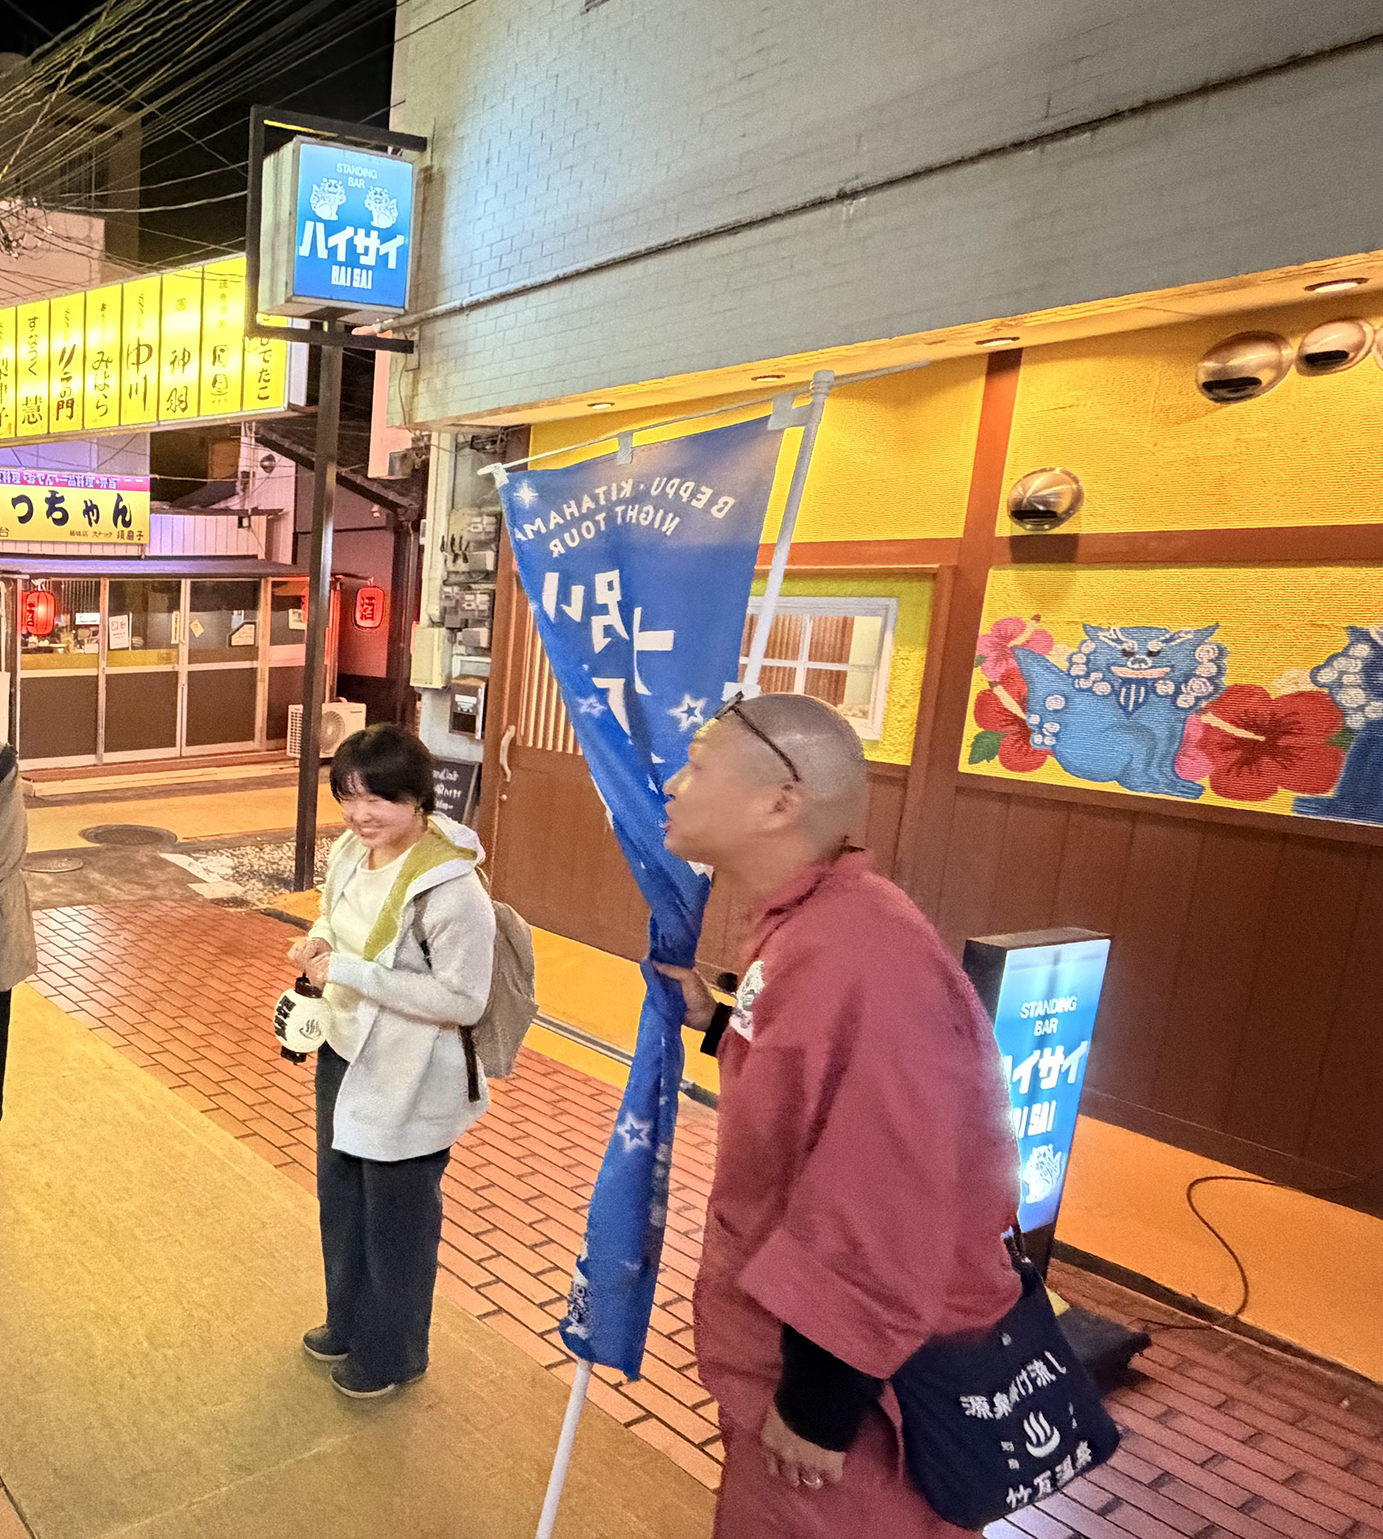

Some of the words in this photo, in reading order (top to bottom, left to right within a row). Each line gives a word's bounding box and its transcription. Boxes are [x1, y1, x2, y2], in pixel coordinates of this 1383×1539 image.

[336, 163, 378, 179] STANDING
[347, 177, 366, 188] BAR
[298, 220, 405, 269] ハイサイ
[331, 265, 351, 286] HAI
[352, 267, 373, 289] SAI
[1020, 995, 1077, 1019] STANDING
[1034, 1017, 1058, 1036] BAR
